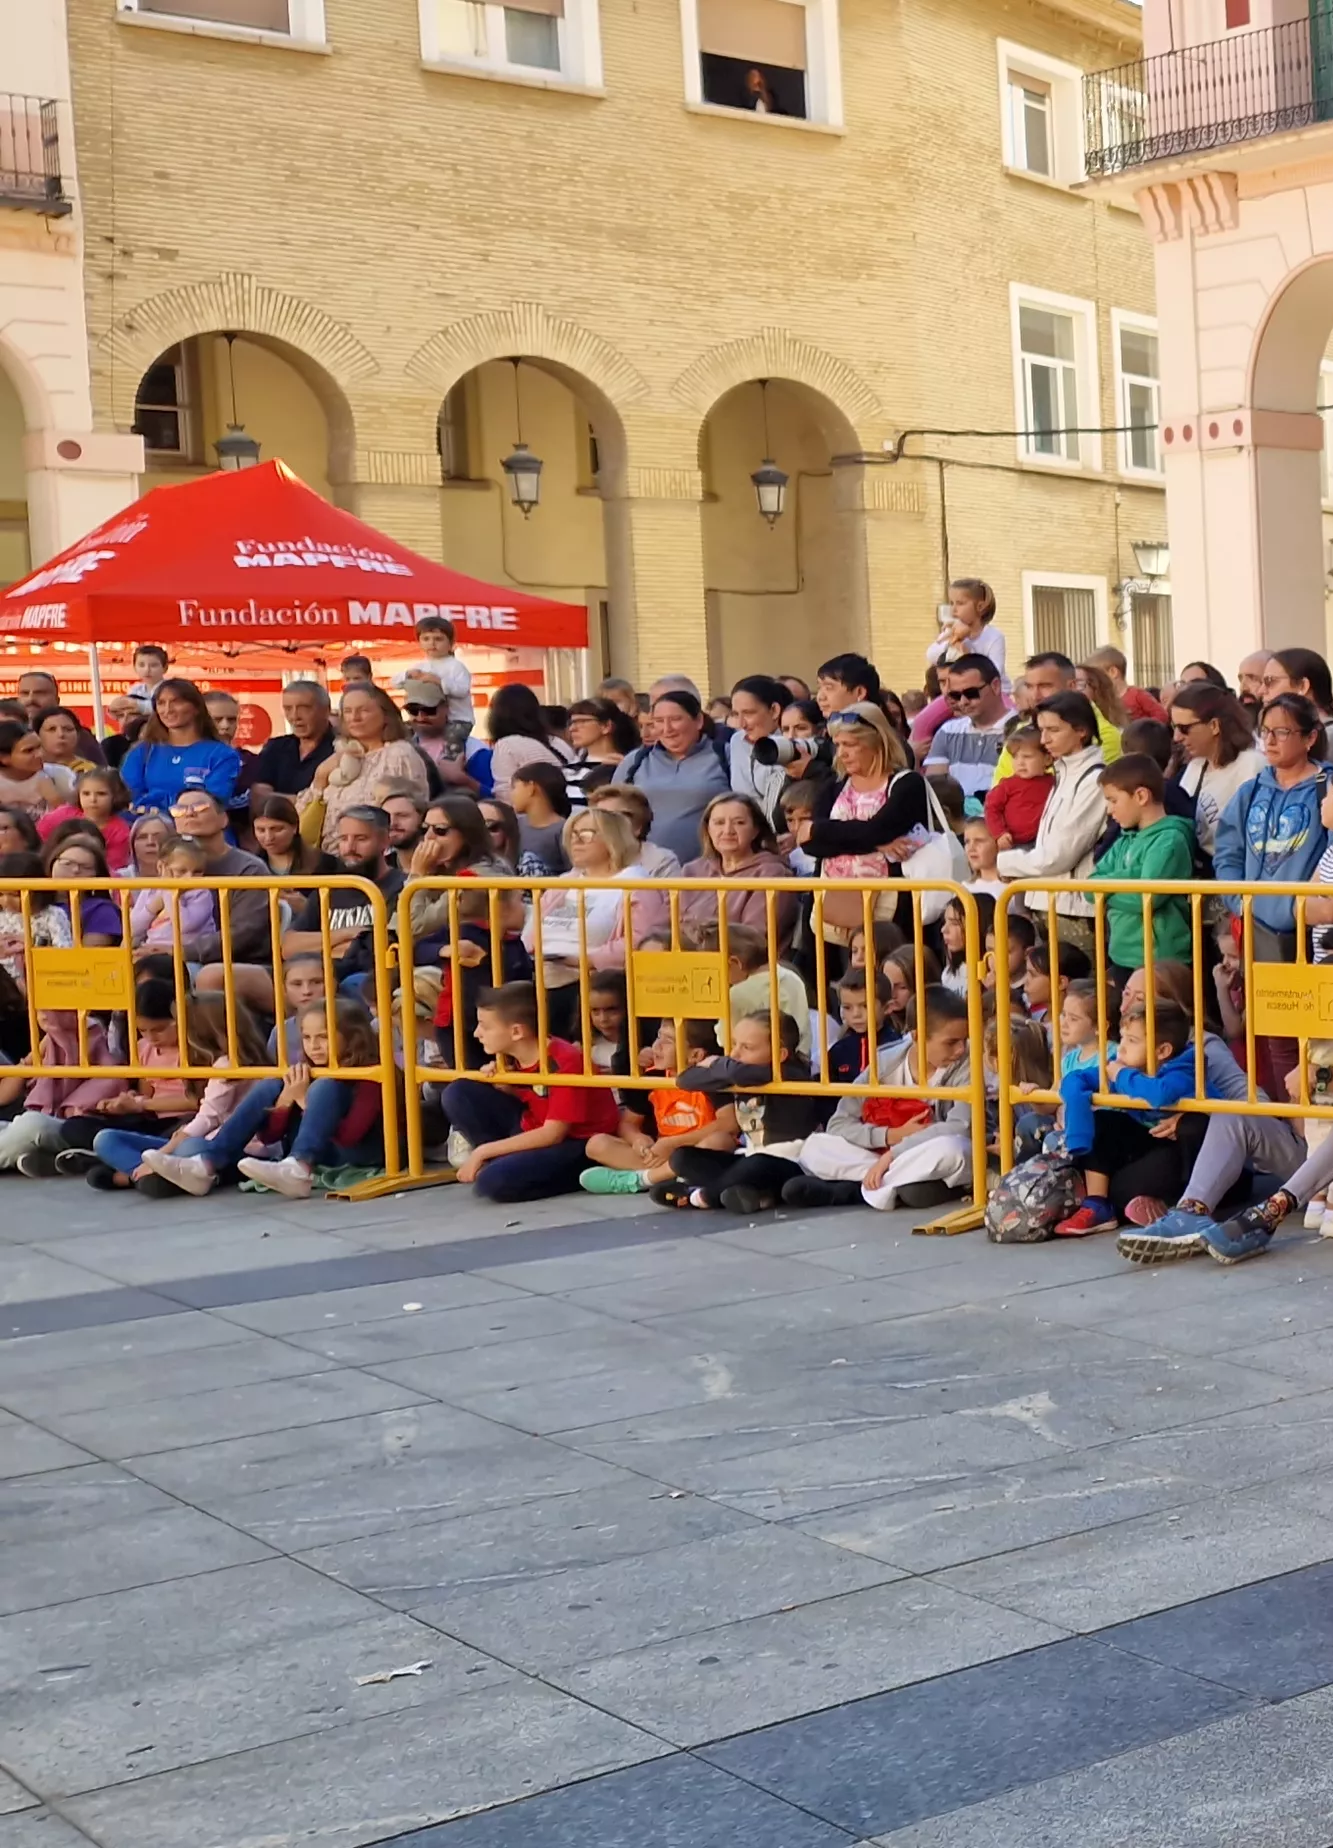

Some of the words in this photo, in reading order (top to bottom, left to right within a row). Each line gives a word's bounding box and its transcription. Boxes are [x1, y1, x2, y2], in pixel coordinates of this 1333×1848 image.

[233, 536, 396, 563] Fundación
[233, 553, 414, 577] MAPFRE
[20, 602, 68, 629] MAPFRE
[175, 599, 341, 627] Fundación
[348, 600, 520, 630] MAPFRE
